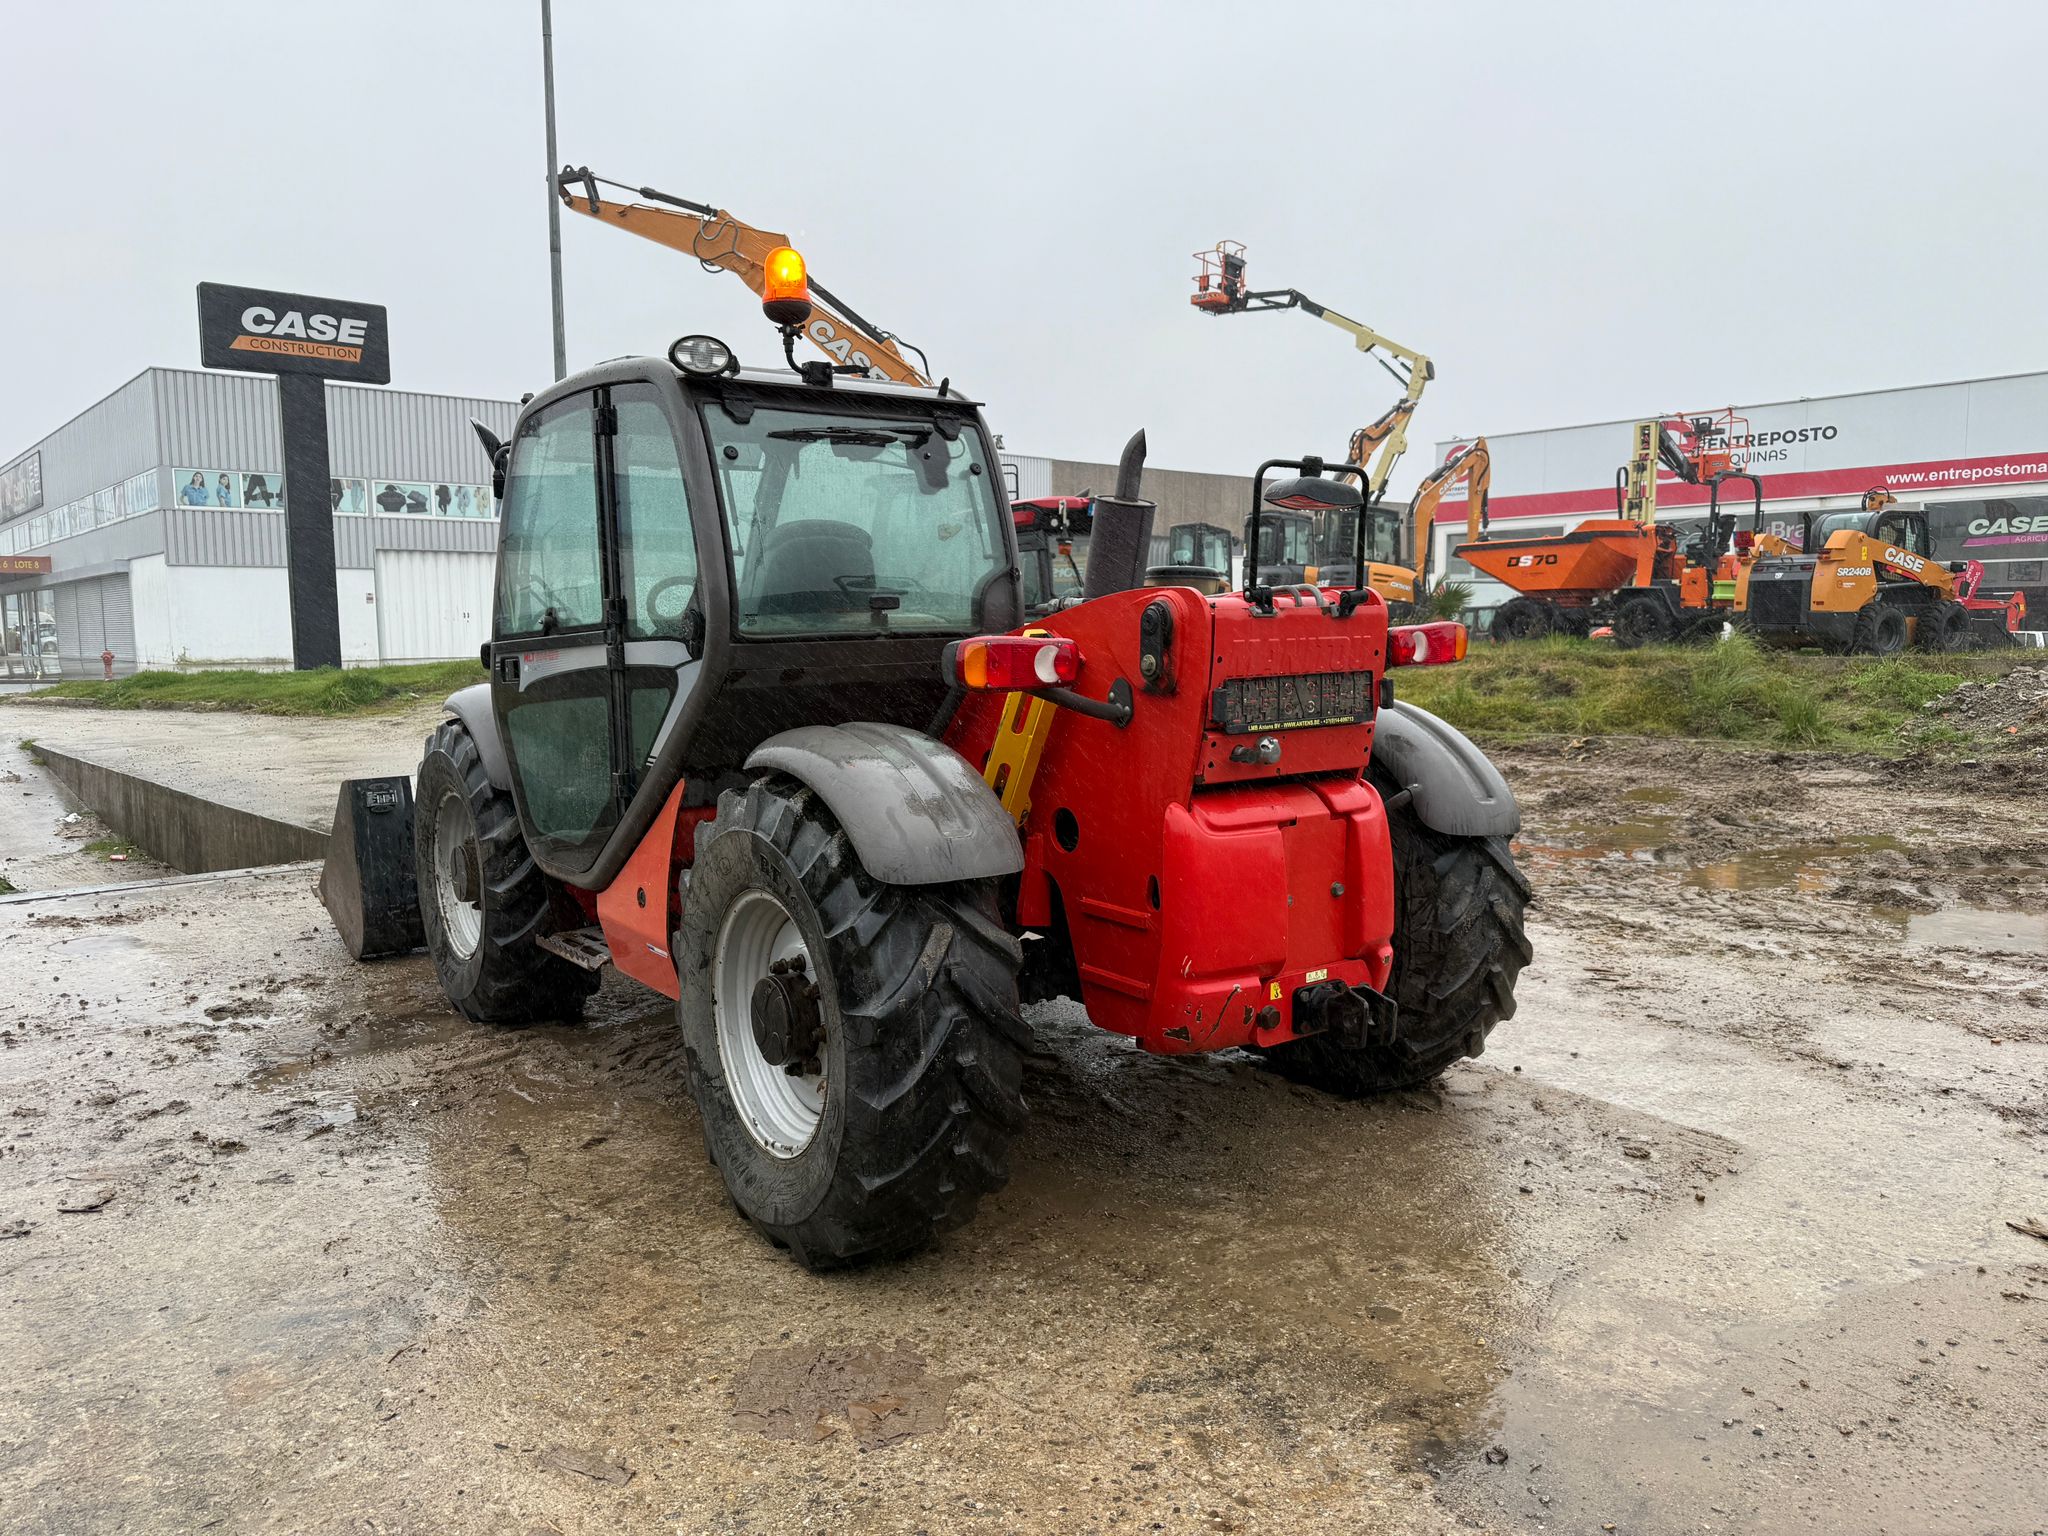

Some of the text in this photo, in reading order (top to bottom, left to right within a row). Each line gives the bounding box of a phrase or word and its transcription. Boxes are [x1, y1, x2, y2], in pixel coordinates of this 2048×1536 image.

[241, 306, 368, 345] CASE
[250, 338, 358, 360] CONSTRUCTION
[1707, 425, 1838, 449] ENTREPOSTO
[1729, 448, 1788, 466] QUINAS
[1968, 515, 2048, 536] CASE
[14, 560, 33, 569] LOTE
[1507, 554, 1558, 568] DS70
[1884, 547, 1925, 573] CASE
[1836, 567, 1872, 577] SR240B
